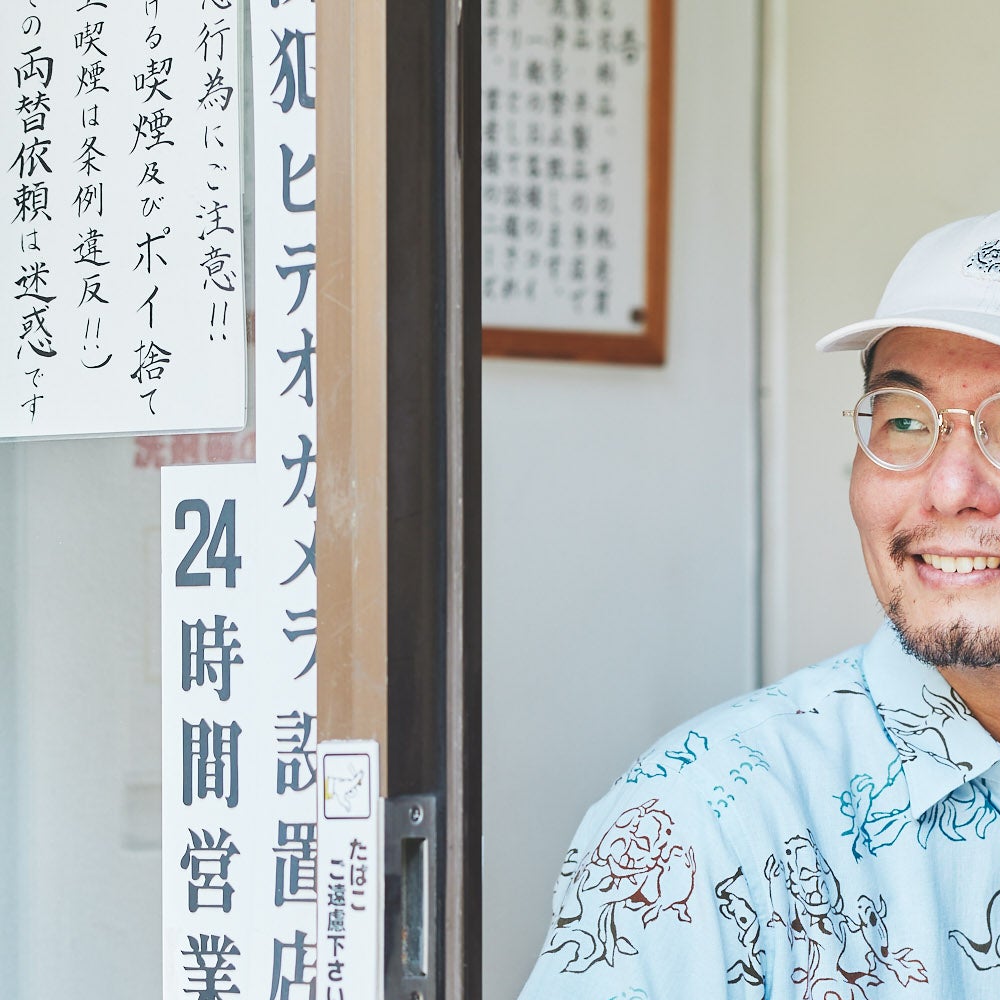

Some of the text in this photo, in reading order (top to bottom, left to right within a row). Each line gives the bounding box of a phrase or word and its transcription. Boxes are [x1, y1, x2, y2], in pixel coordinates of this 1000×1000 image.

[8, 0, 58, 423] の両替依頼は迷惑です
